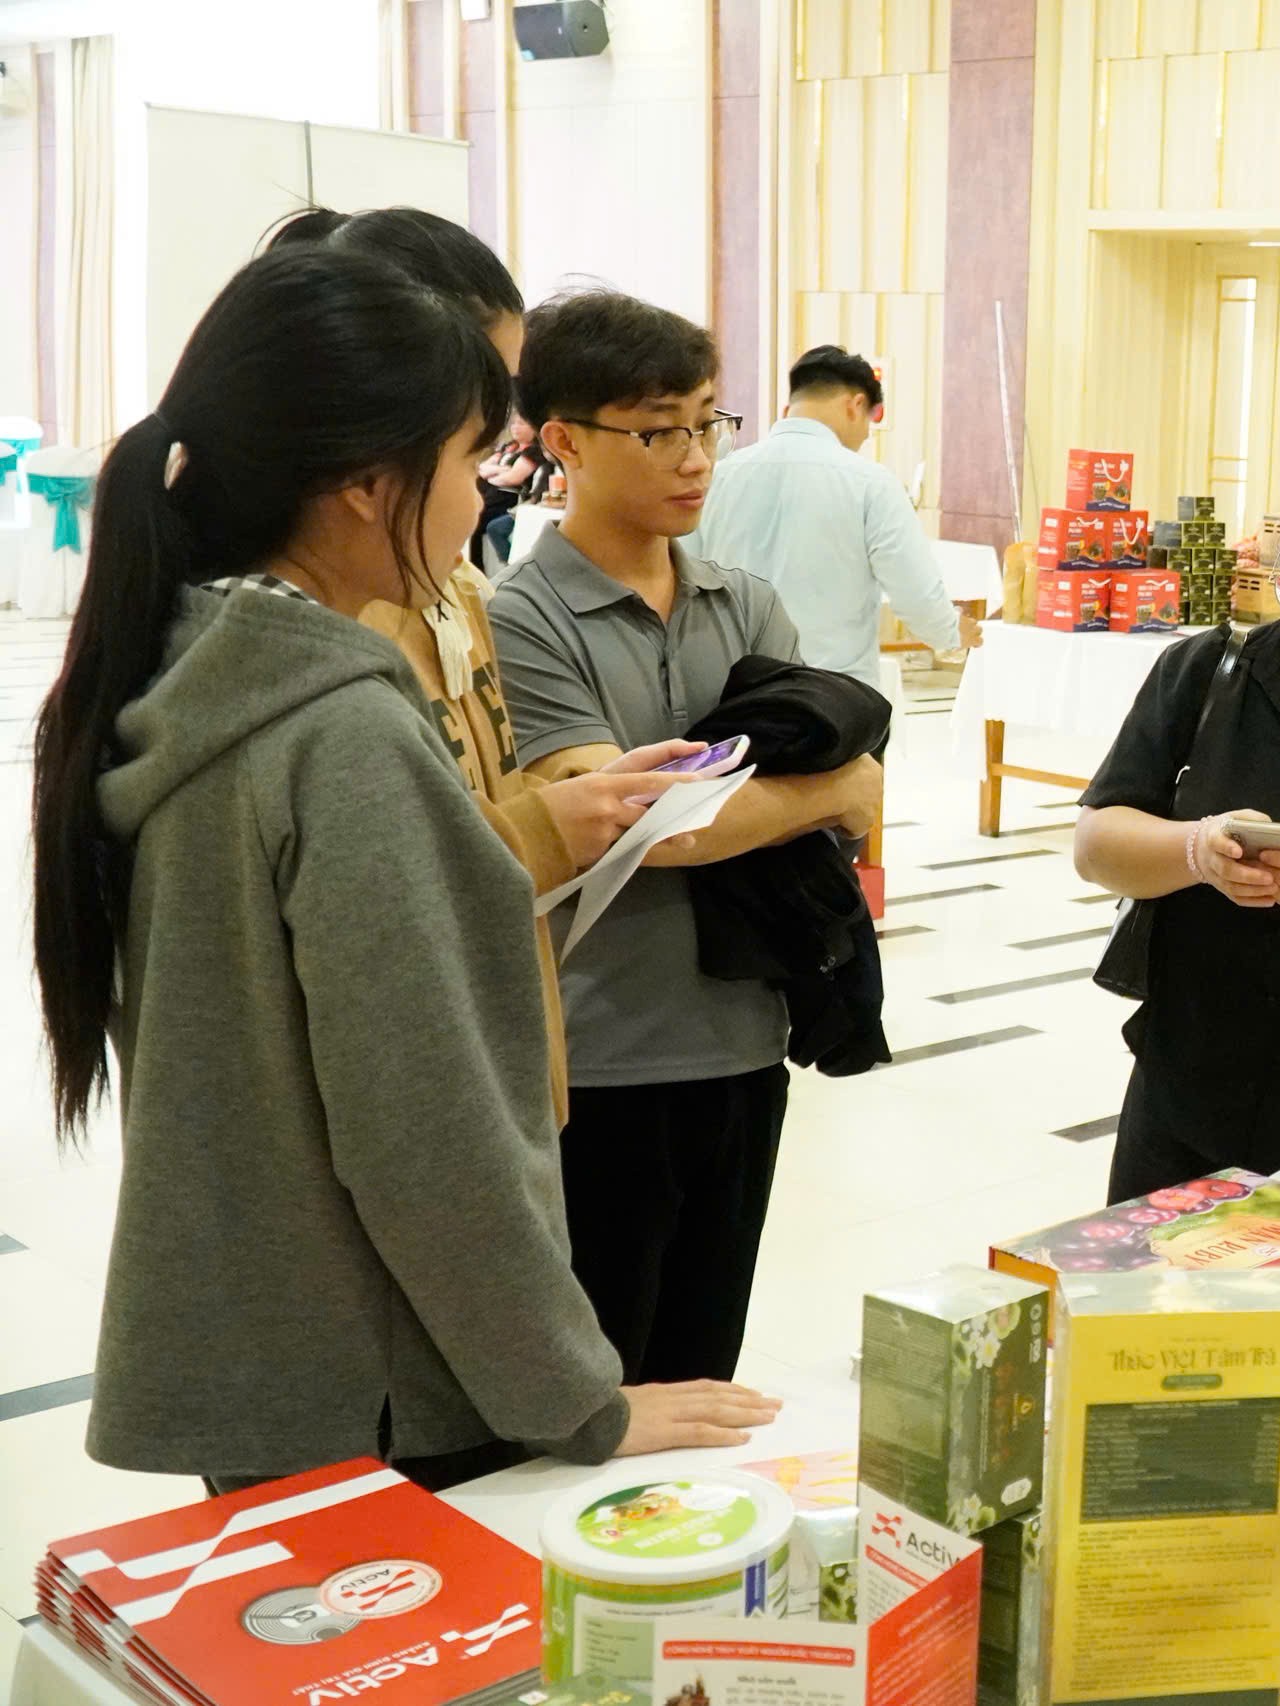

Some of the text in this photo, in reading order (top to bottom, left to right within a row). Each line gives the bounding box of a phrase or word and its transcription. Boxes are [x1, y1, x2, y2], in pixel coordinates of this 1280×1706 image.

[906, 1532, 961, 1568] Activ
[340, 1568, 391, 1591] Activ
[308, 1646, 440, 1706] Activ
